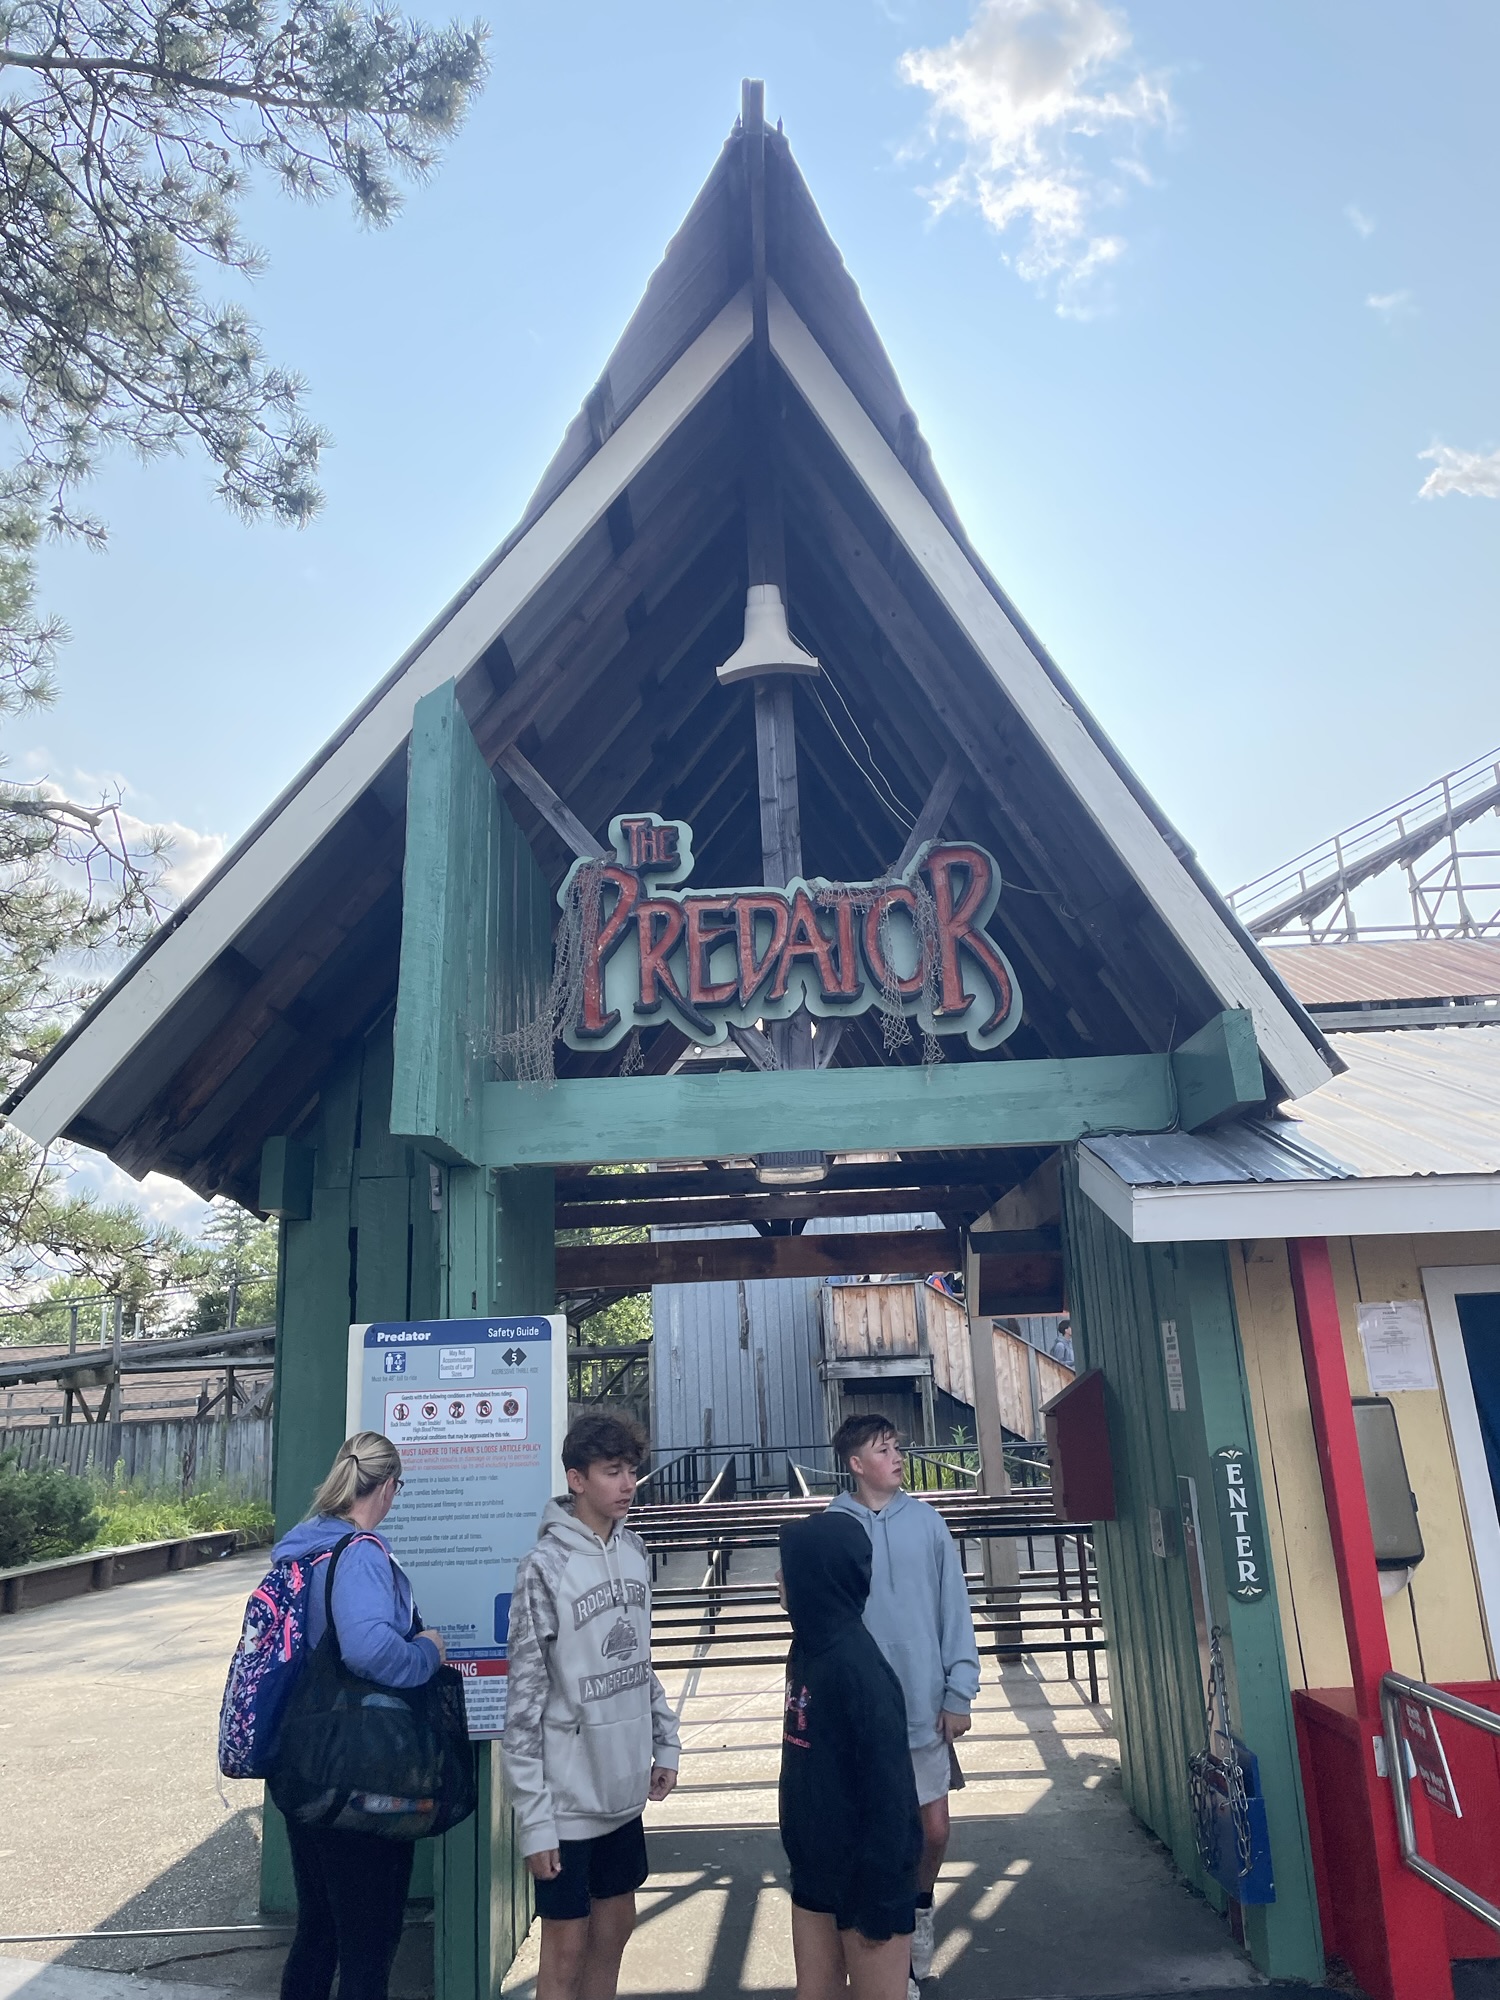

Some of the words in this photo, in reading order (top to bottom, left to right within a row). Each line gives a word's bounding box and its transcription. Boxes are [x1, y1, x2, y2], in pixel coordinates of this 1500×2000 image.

[621, 818, 680, 873] THE
[576, 845, 1013, 1038] PREDATOR
[376, 1331, 432, 1343] Predator
[487, 1327, 515, 1339] Safety
[516, 1326, 540, 1336] Guide
[511, 1352, 518, 1362] 5
[401, 1448, 416, 1456] MUST
[418, 1447, 439, 1456] ADHERE
[440, 1447, 448, 1455] TO
[449, 1446, 459, 1455] THE
[480, 1445, 498, 1453] LOOSE
[499, 1444, 521, 1453] ARTICLE
[522, 1443, 541, 1452] POLICY
[1226, 1464, 1260, 1583] ENTER
